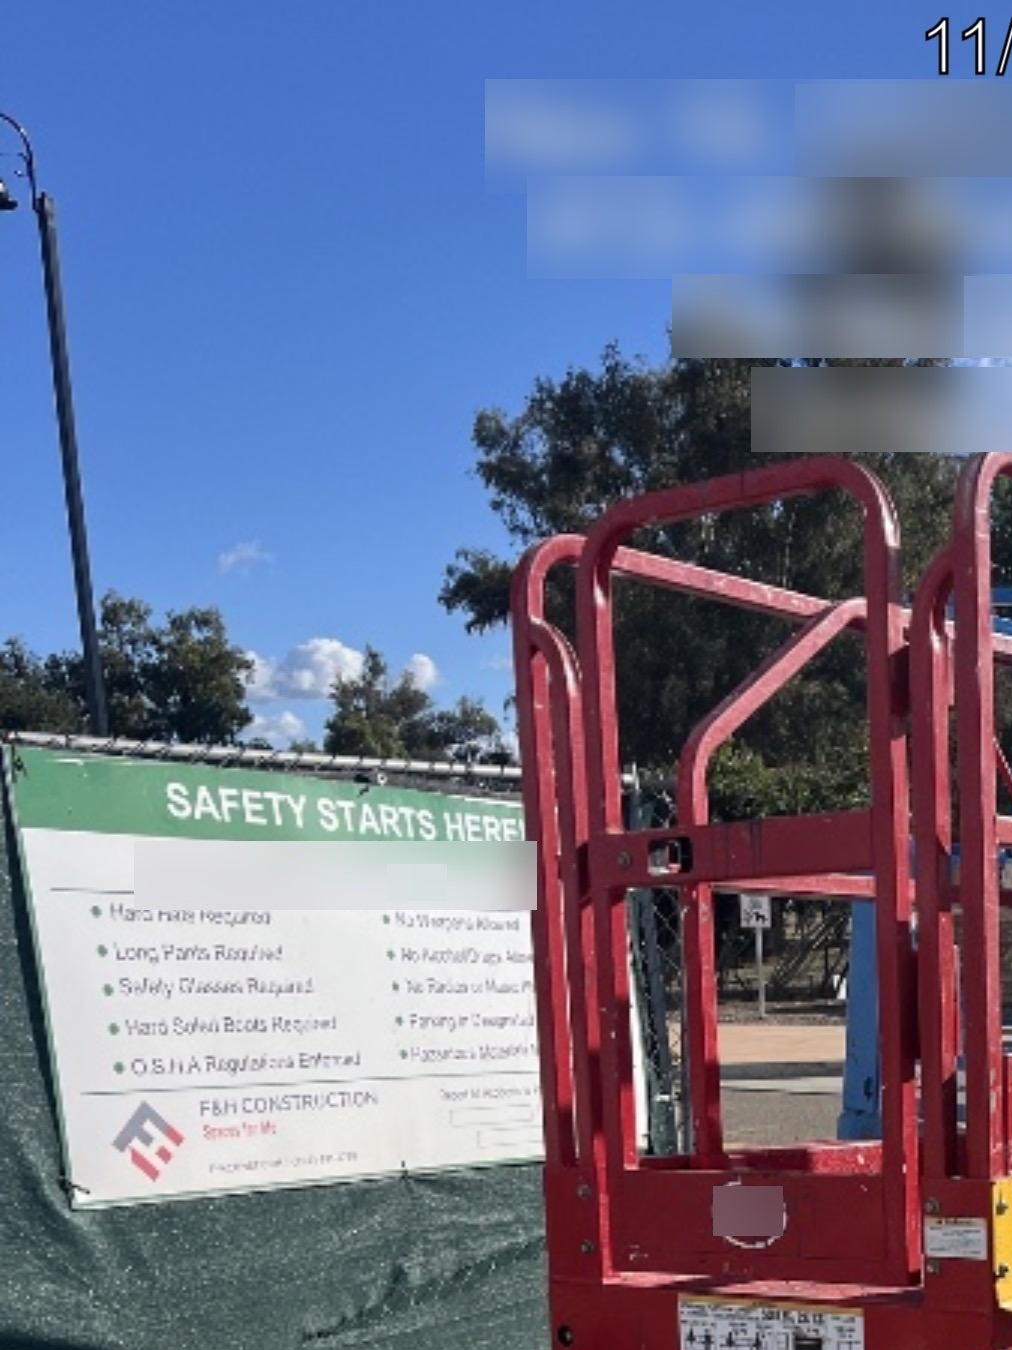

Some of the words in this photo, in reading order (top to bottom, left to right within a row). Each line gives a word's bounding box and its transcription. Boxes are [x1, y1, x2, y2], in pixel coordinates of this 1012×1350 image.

[165, 782, 307, 828] SAFETY
[316, 796, 437, 840] STARTS
[114, 943, 160, 964] Long
[162, 944, 211, 961] Pants
[118, 976, 174, 999] Safety
[125, 1018, 169, 1036] Hard
[222, 1016, 268, 1034] Boots
[199, 1098, 238, 1118] F&H
[241, 1091, 379, 1115] CONSTRUCTION
